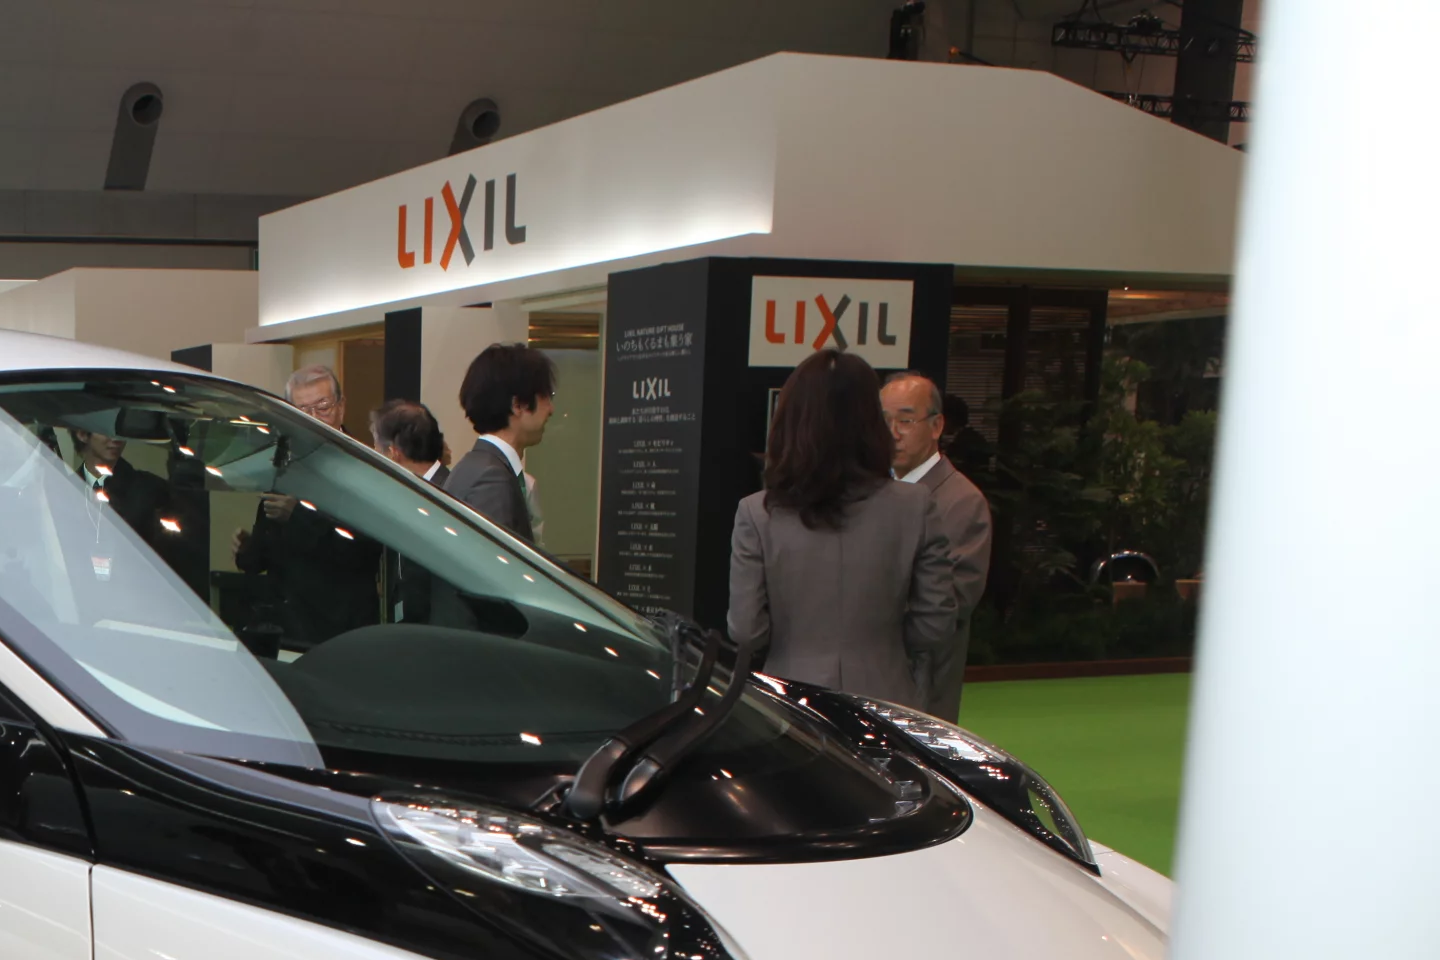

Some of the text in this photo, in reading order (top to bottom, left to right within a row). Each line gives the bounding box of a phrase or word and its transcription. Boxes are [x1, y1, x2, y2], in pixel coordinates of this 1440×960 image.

[397, 172, 527, 272] LIXIL
[764, 293, 897, 352] LIXIL
[632, 377, 671, 400] LIXIL
